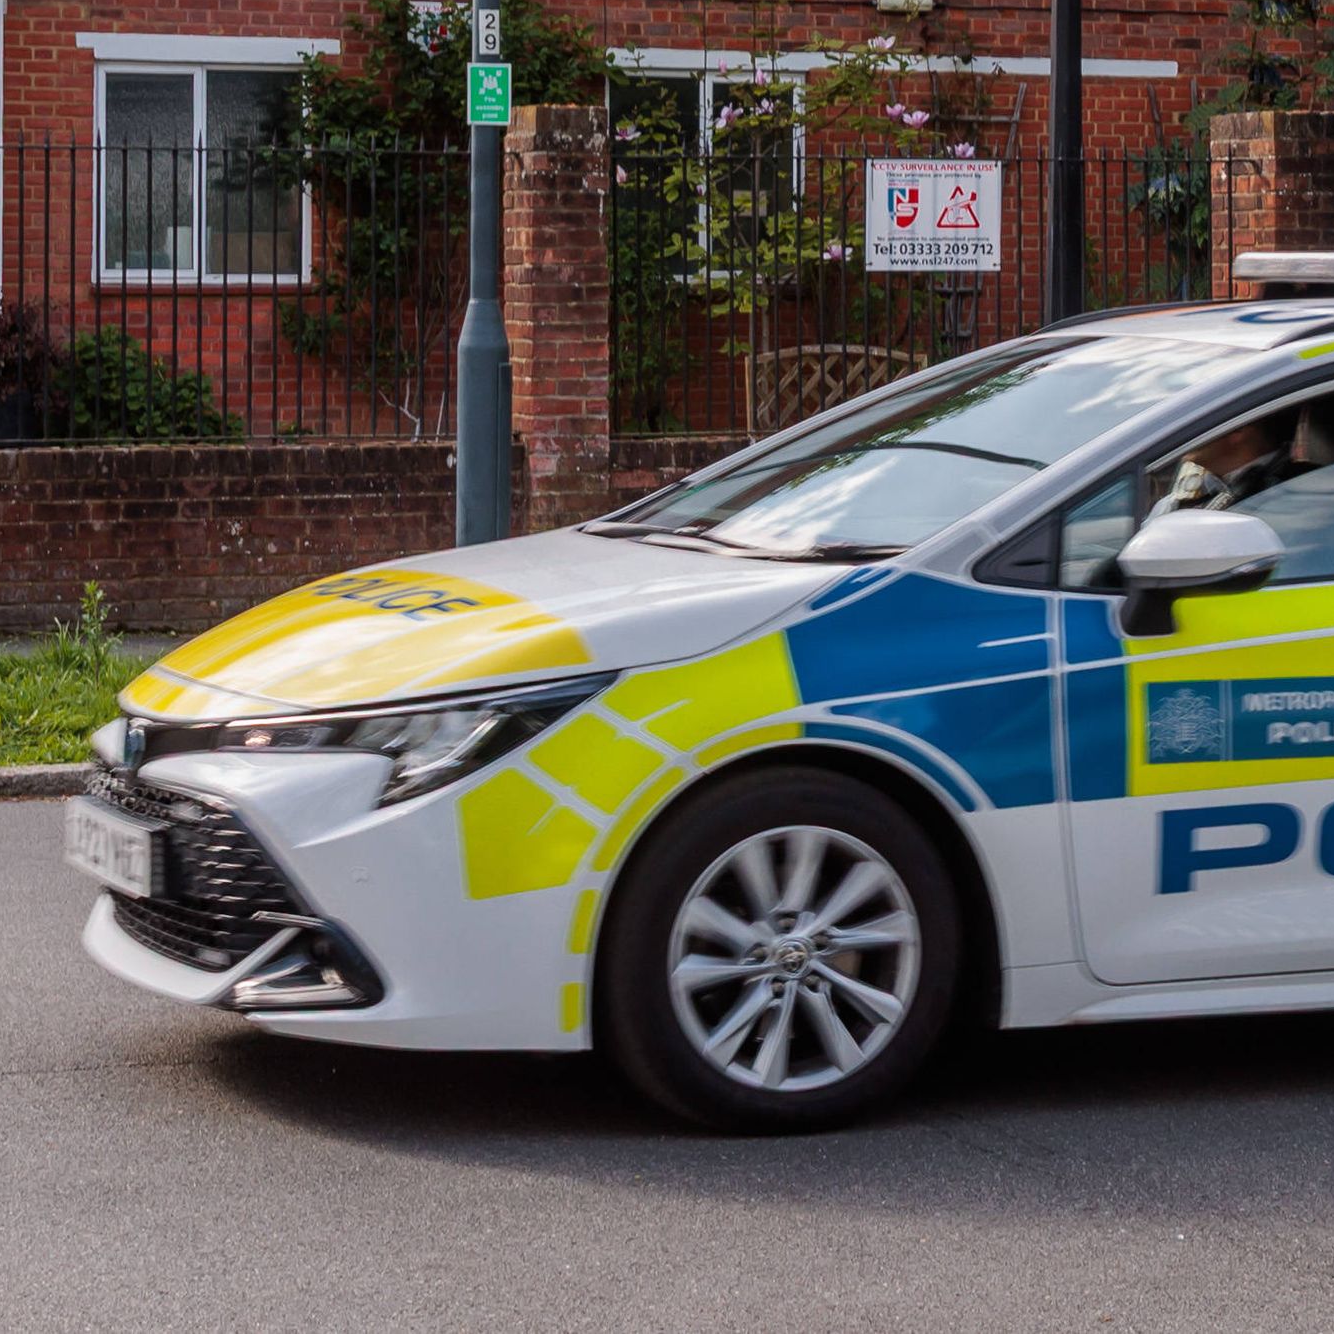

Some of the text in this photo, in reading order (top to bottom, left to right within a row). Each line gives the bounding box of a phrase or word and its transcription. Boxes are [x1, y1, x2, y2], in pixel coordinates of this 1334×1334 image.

[873, 163, 896, 171] CCTV
[901, 163, 964, 172] SURVEILLANCE
[874, 243, 994, 256] Tel: 03333 209 712
[890, 257, 978, 266] www.nsl247.com
